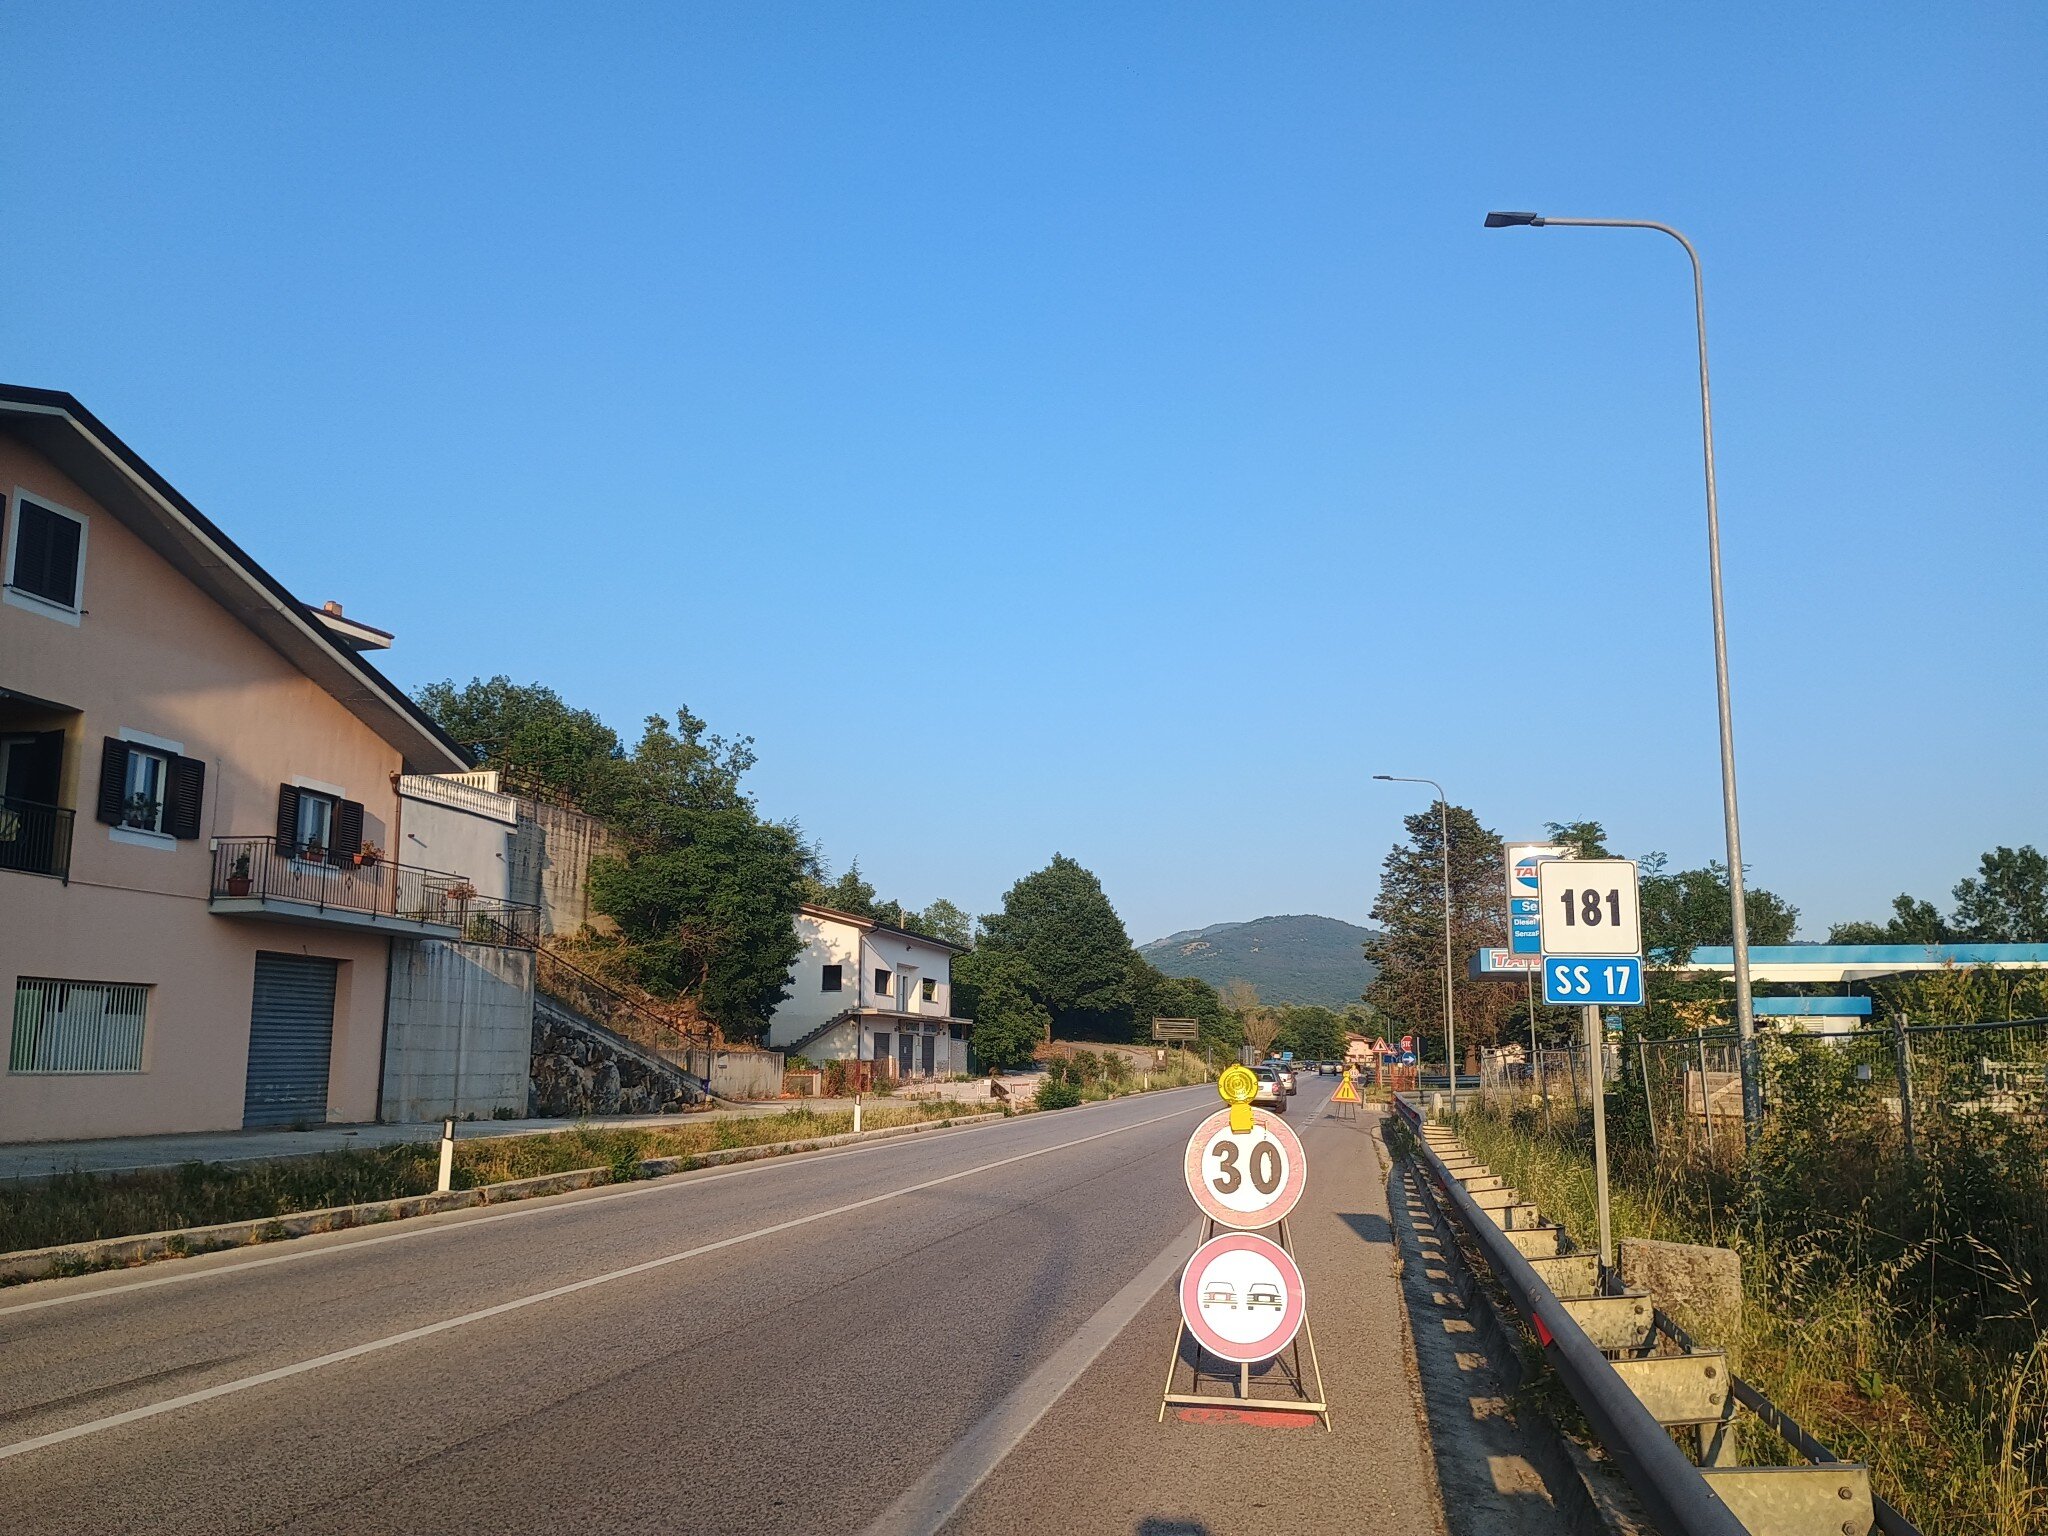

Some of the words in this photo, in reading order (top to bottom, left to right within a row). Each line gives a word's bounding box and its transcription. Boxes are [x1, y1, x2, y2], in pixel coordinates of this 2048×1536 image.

[1514, 868, 1539, 876] TA
[1521, 901, 1538, 912] Se
[1561, 889, 1620, 926] 181
[1555, 965, 1591, 995] SS
[1603, 966, 1630, 995] 17
[1212, 1140, 1282, 1195] 30
